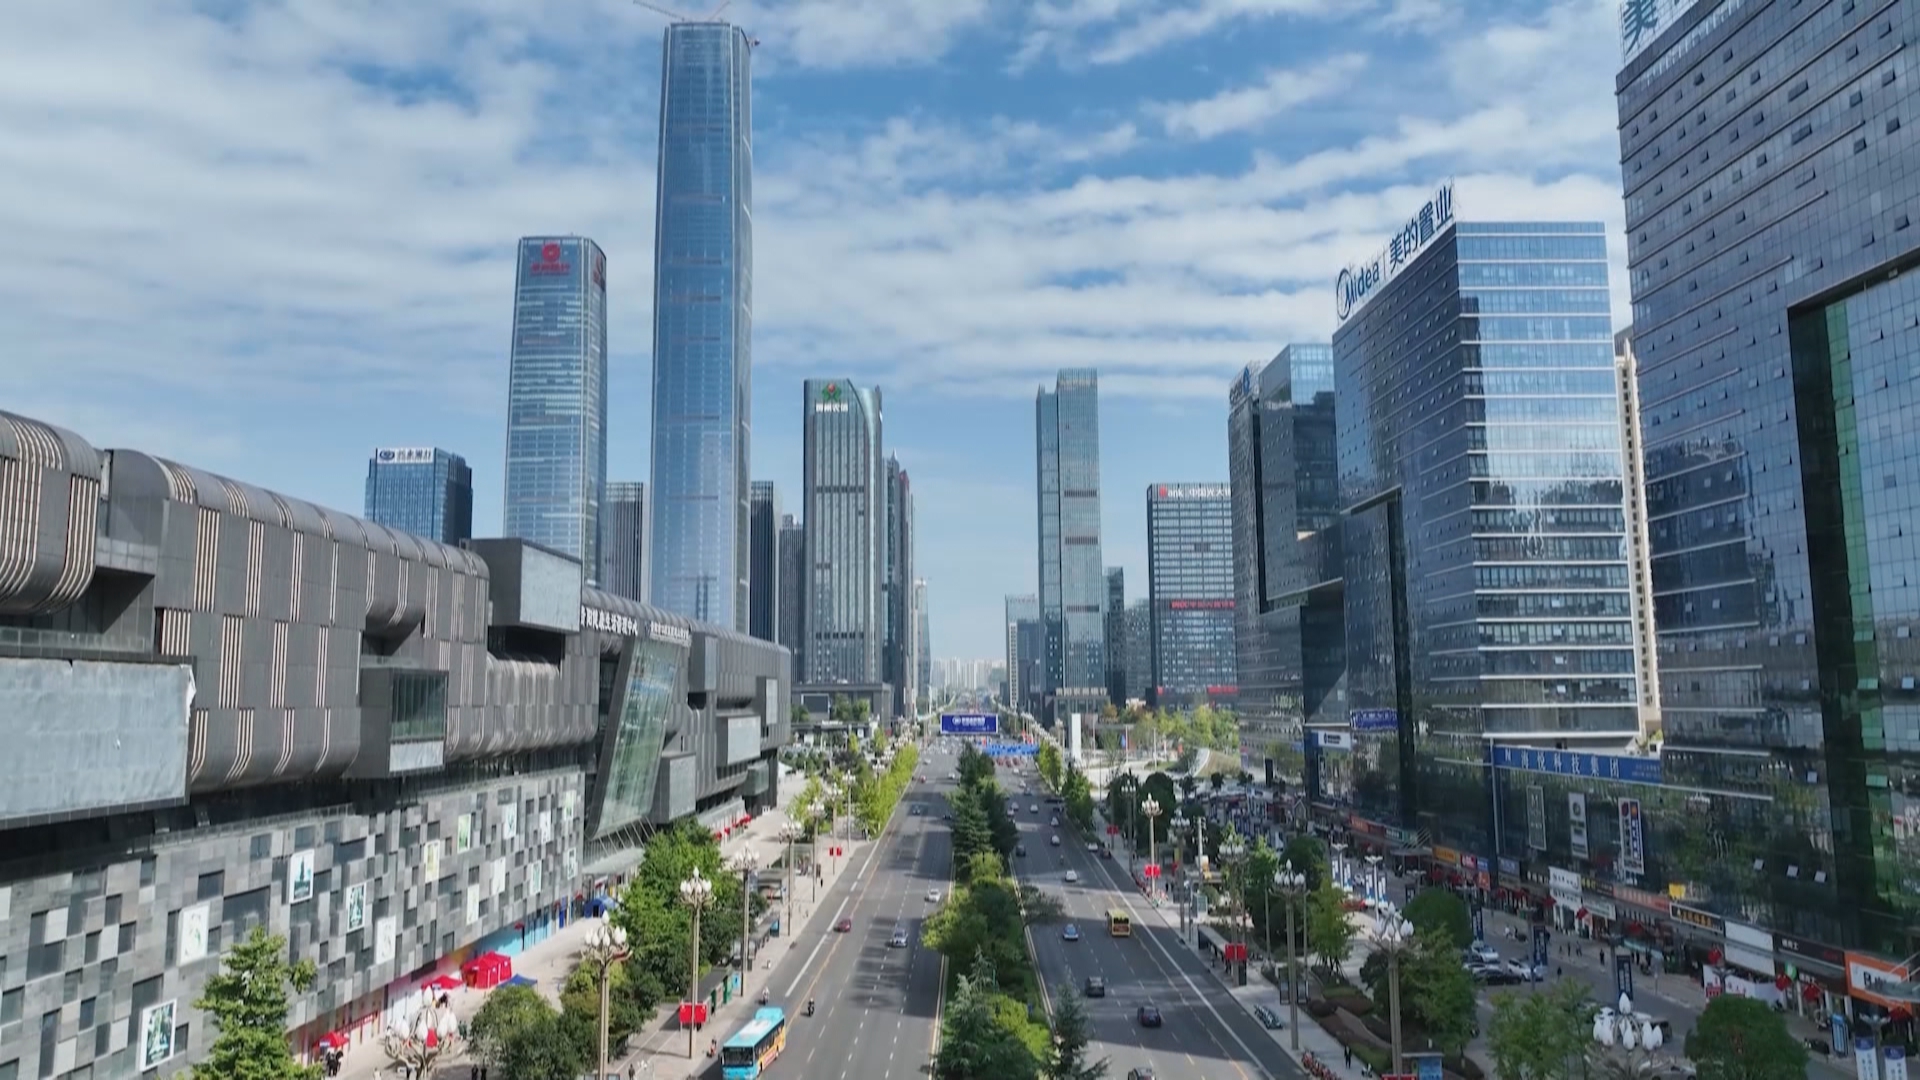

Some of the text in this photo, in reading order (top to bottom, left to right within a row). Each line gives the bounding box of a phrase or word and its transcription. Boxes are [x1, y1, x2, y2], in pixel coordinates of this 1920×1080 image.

[1336, 186, 1454, 320] Midea 美的置业
